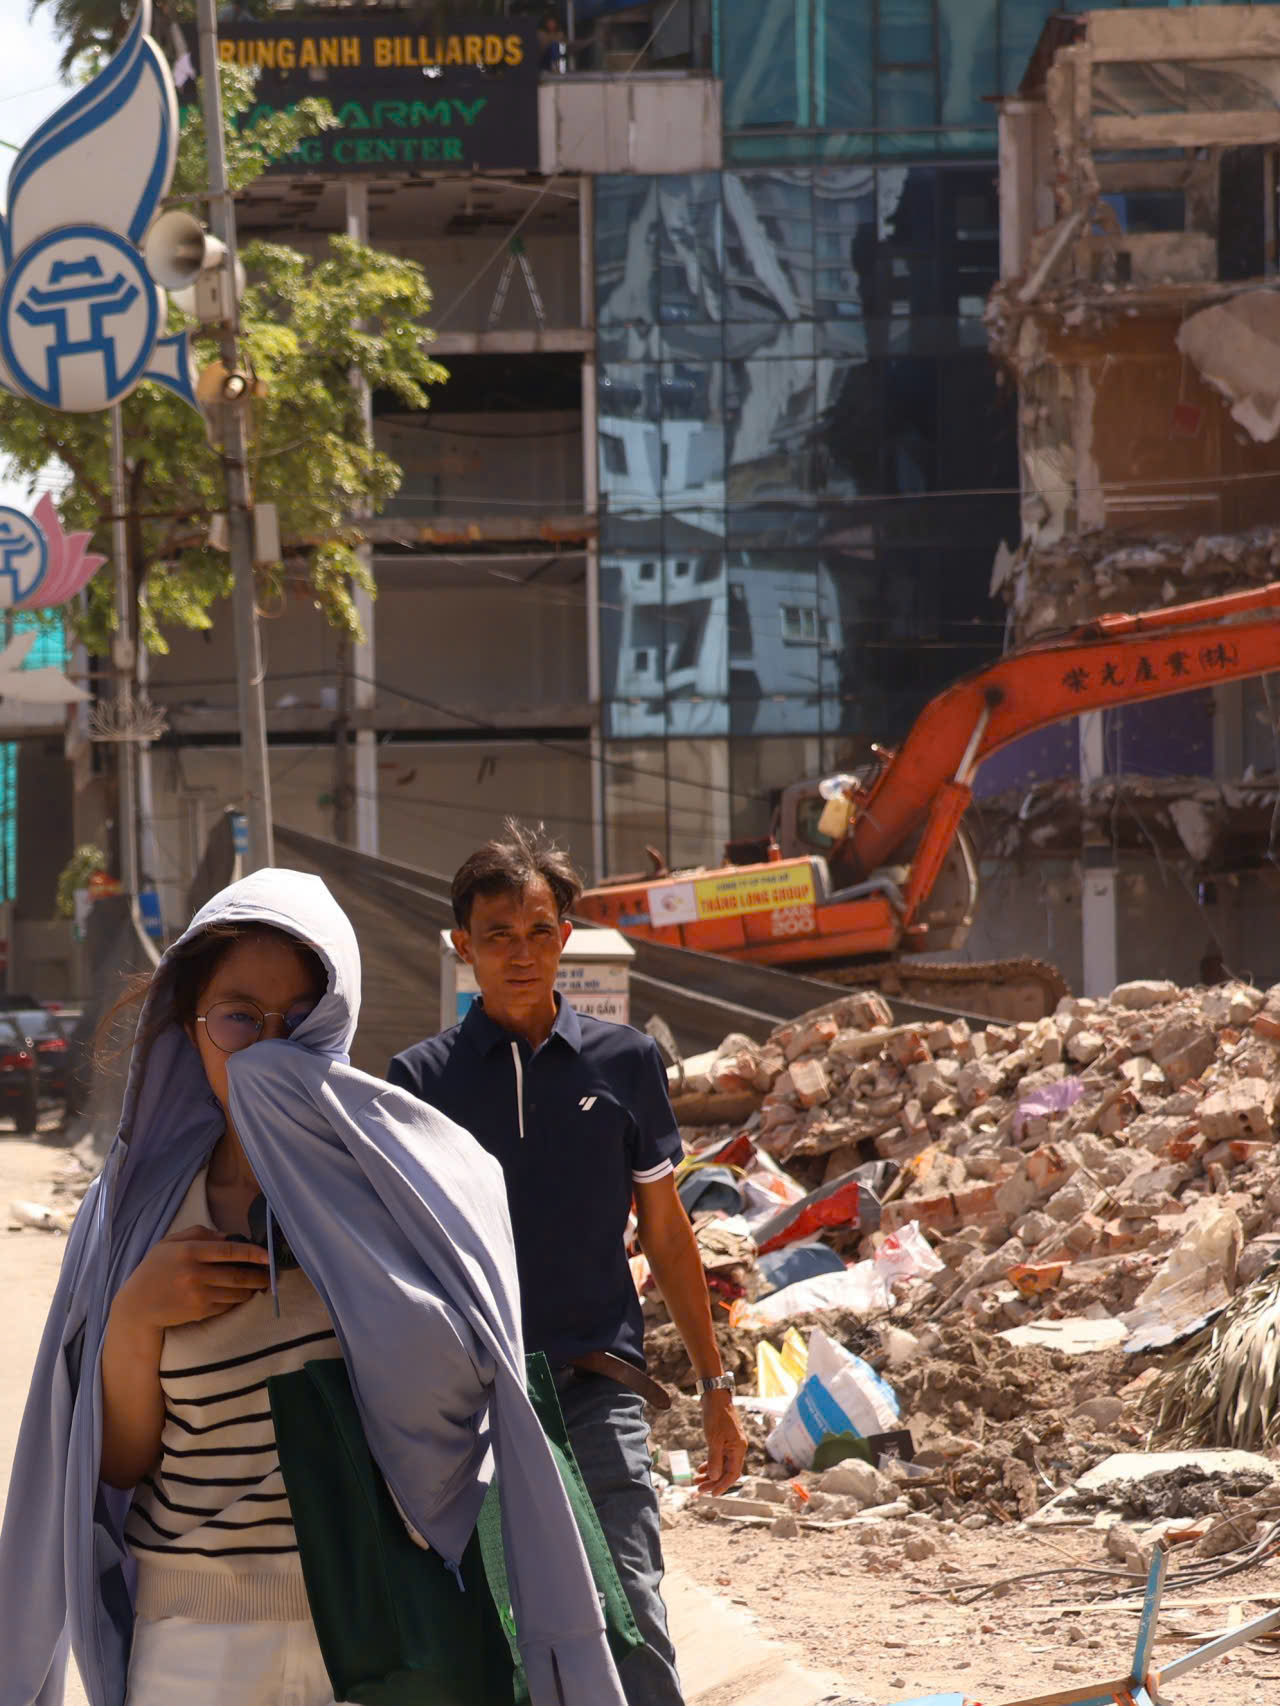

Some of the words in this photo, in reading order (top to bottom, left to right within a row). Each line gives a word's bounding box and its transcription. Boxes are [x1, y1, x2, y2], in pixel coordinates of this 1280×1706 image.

[373, 34, 524, 67] BILLIARDS
[332, 137, 464, 163] CENTER
[772, 884, 810, 905] GROUP
[772, 918, 816, 936] 200
